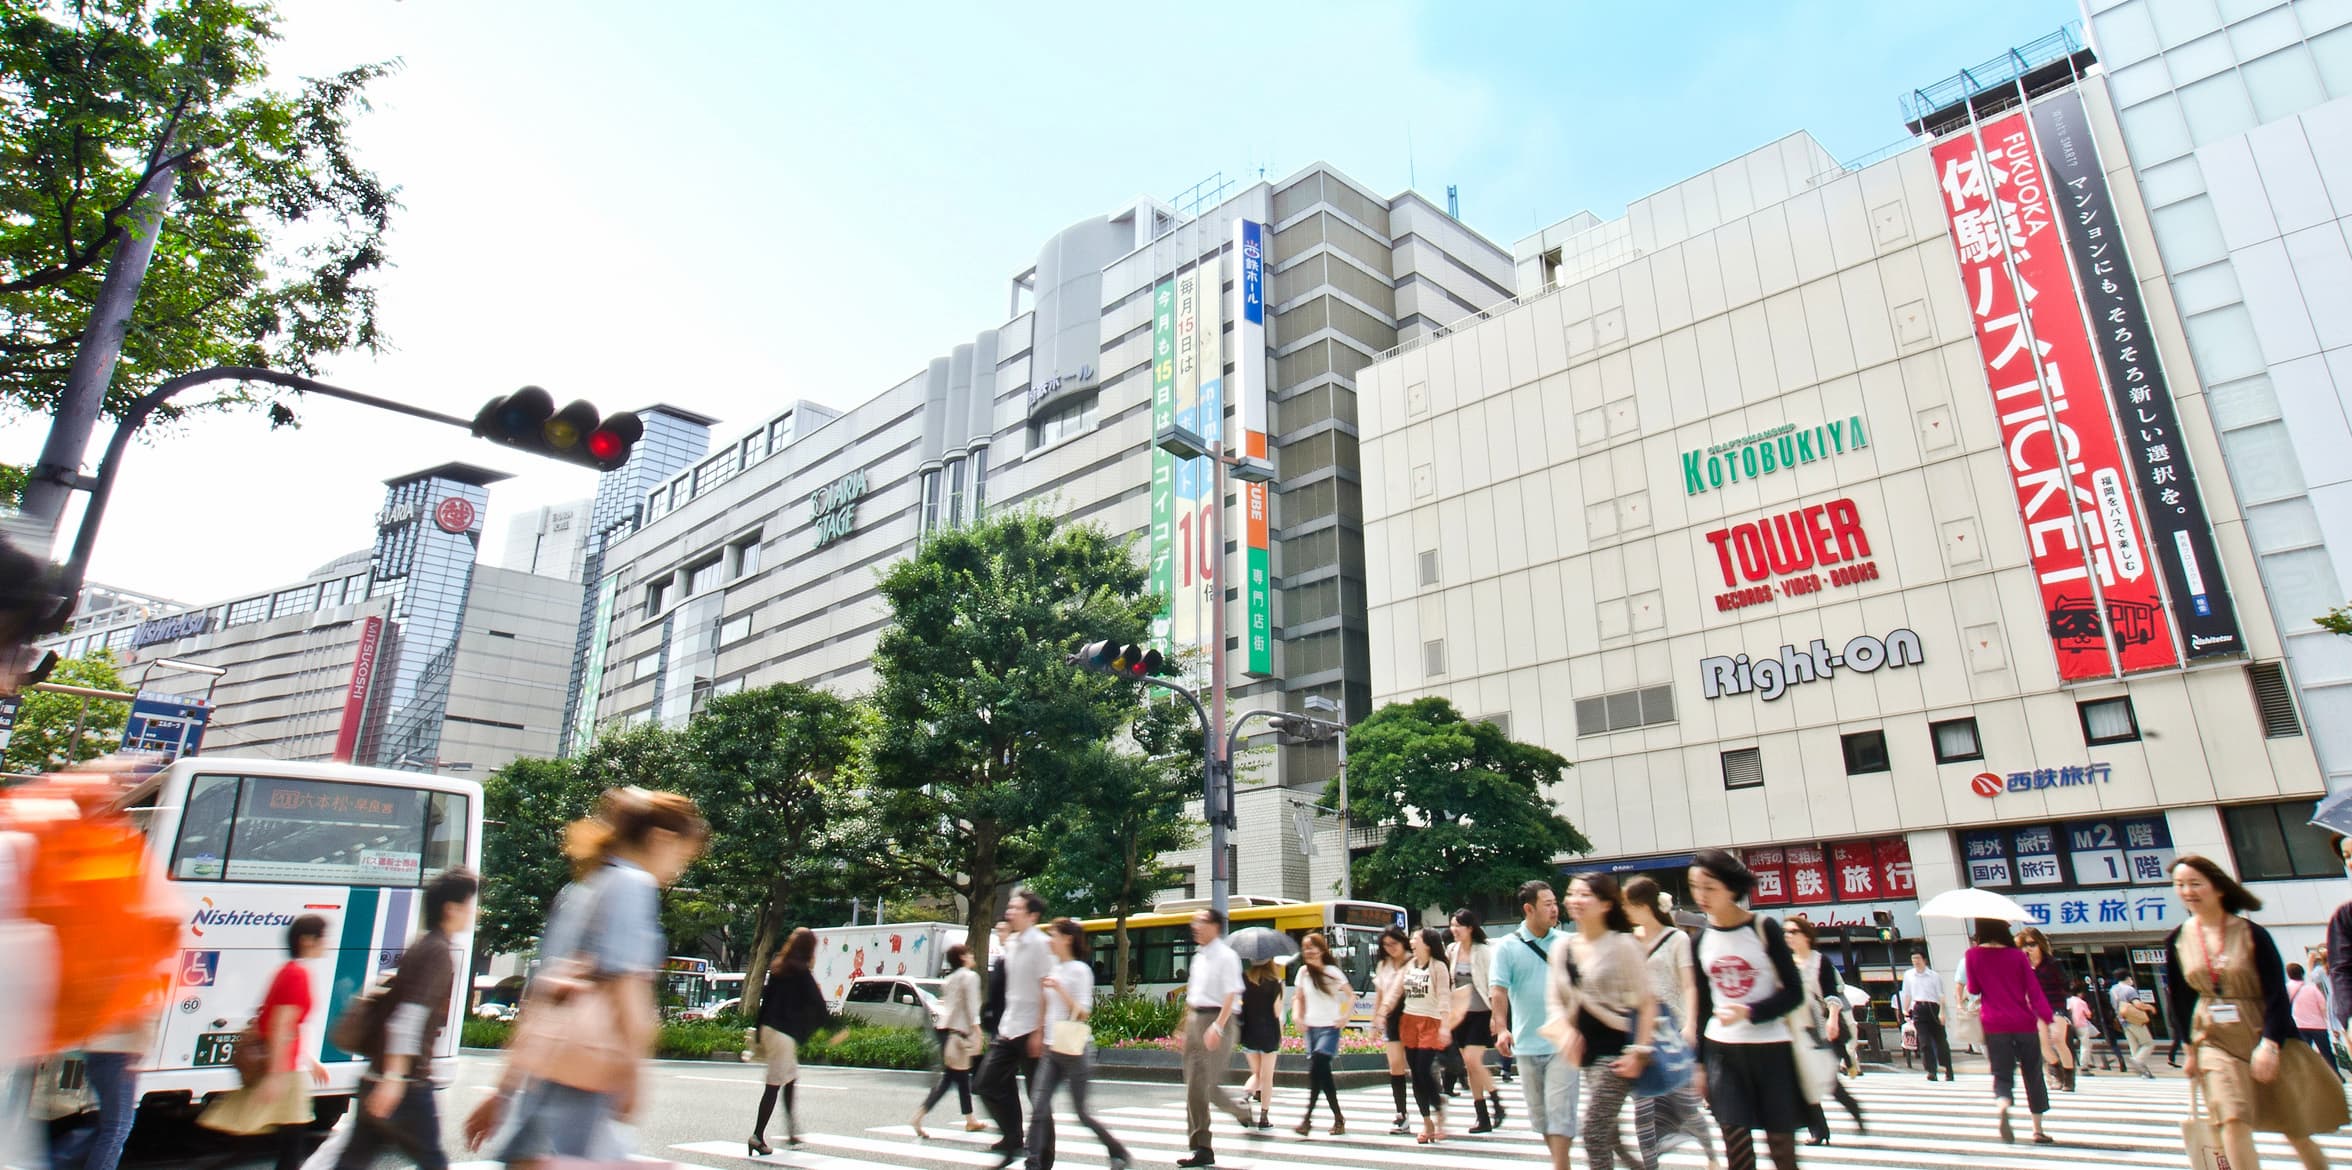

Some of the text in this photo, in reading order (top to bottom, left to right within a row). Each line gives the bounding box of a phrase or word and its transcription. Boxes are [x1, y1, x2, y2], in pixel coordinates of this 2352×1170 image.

[2003, 131, 2048, 236] FUKUOKA
[1178, 277, 1195, 375] 毎月15日は
[2067, 176, 2186, 515] マンションにも、そろそろ新しい選択を。
[1682, 415, 1869, 495] KOTOBUKIYA
[809, 467, 870, 519] SOLARIA
[1250, 481, 1263, 521] UBE
[811, 503, 855, 549] STAGE
[1706, 498, 1872, 587] TOWER
[2101, 476, 2136, 572] 福岡をバスで楽しむ
[1714, 561, 1880, 612] RECORDS VIDEO BOOKS
[132, 612, 209, 648] Nishitetsu
[352, 622, 378, 699] MITSUKOSHI
[1700, 627, 1925, 702] Right-on
[2006, 762, 2112, 794] 西鉄旅行
[1755, 861, 1915, 898] 西鉄旅行
[191, 906, 295, 927] Nishitetsu
[2022, 897, 2167, 926] 西鉄旅行
[183, 1000, 199, 1010] 60
